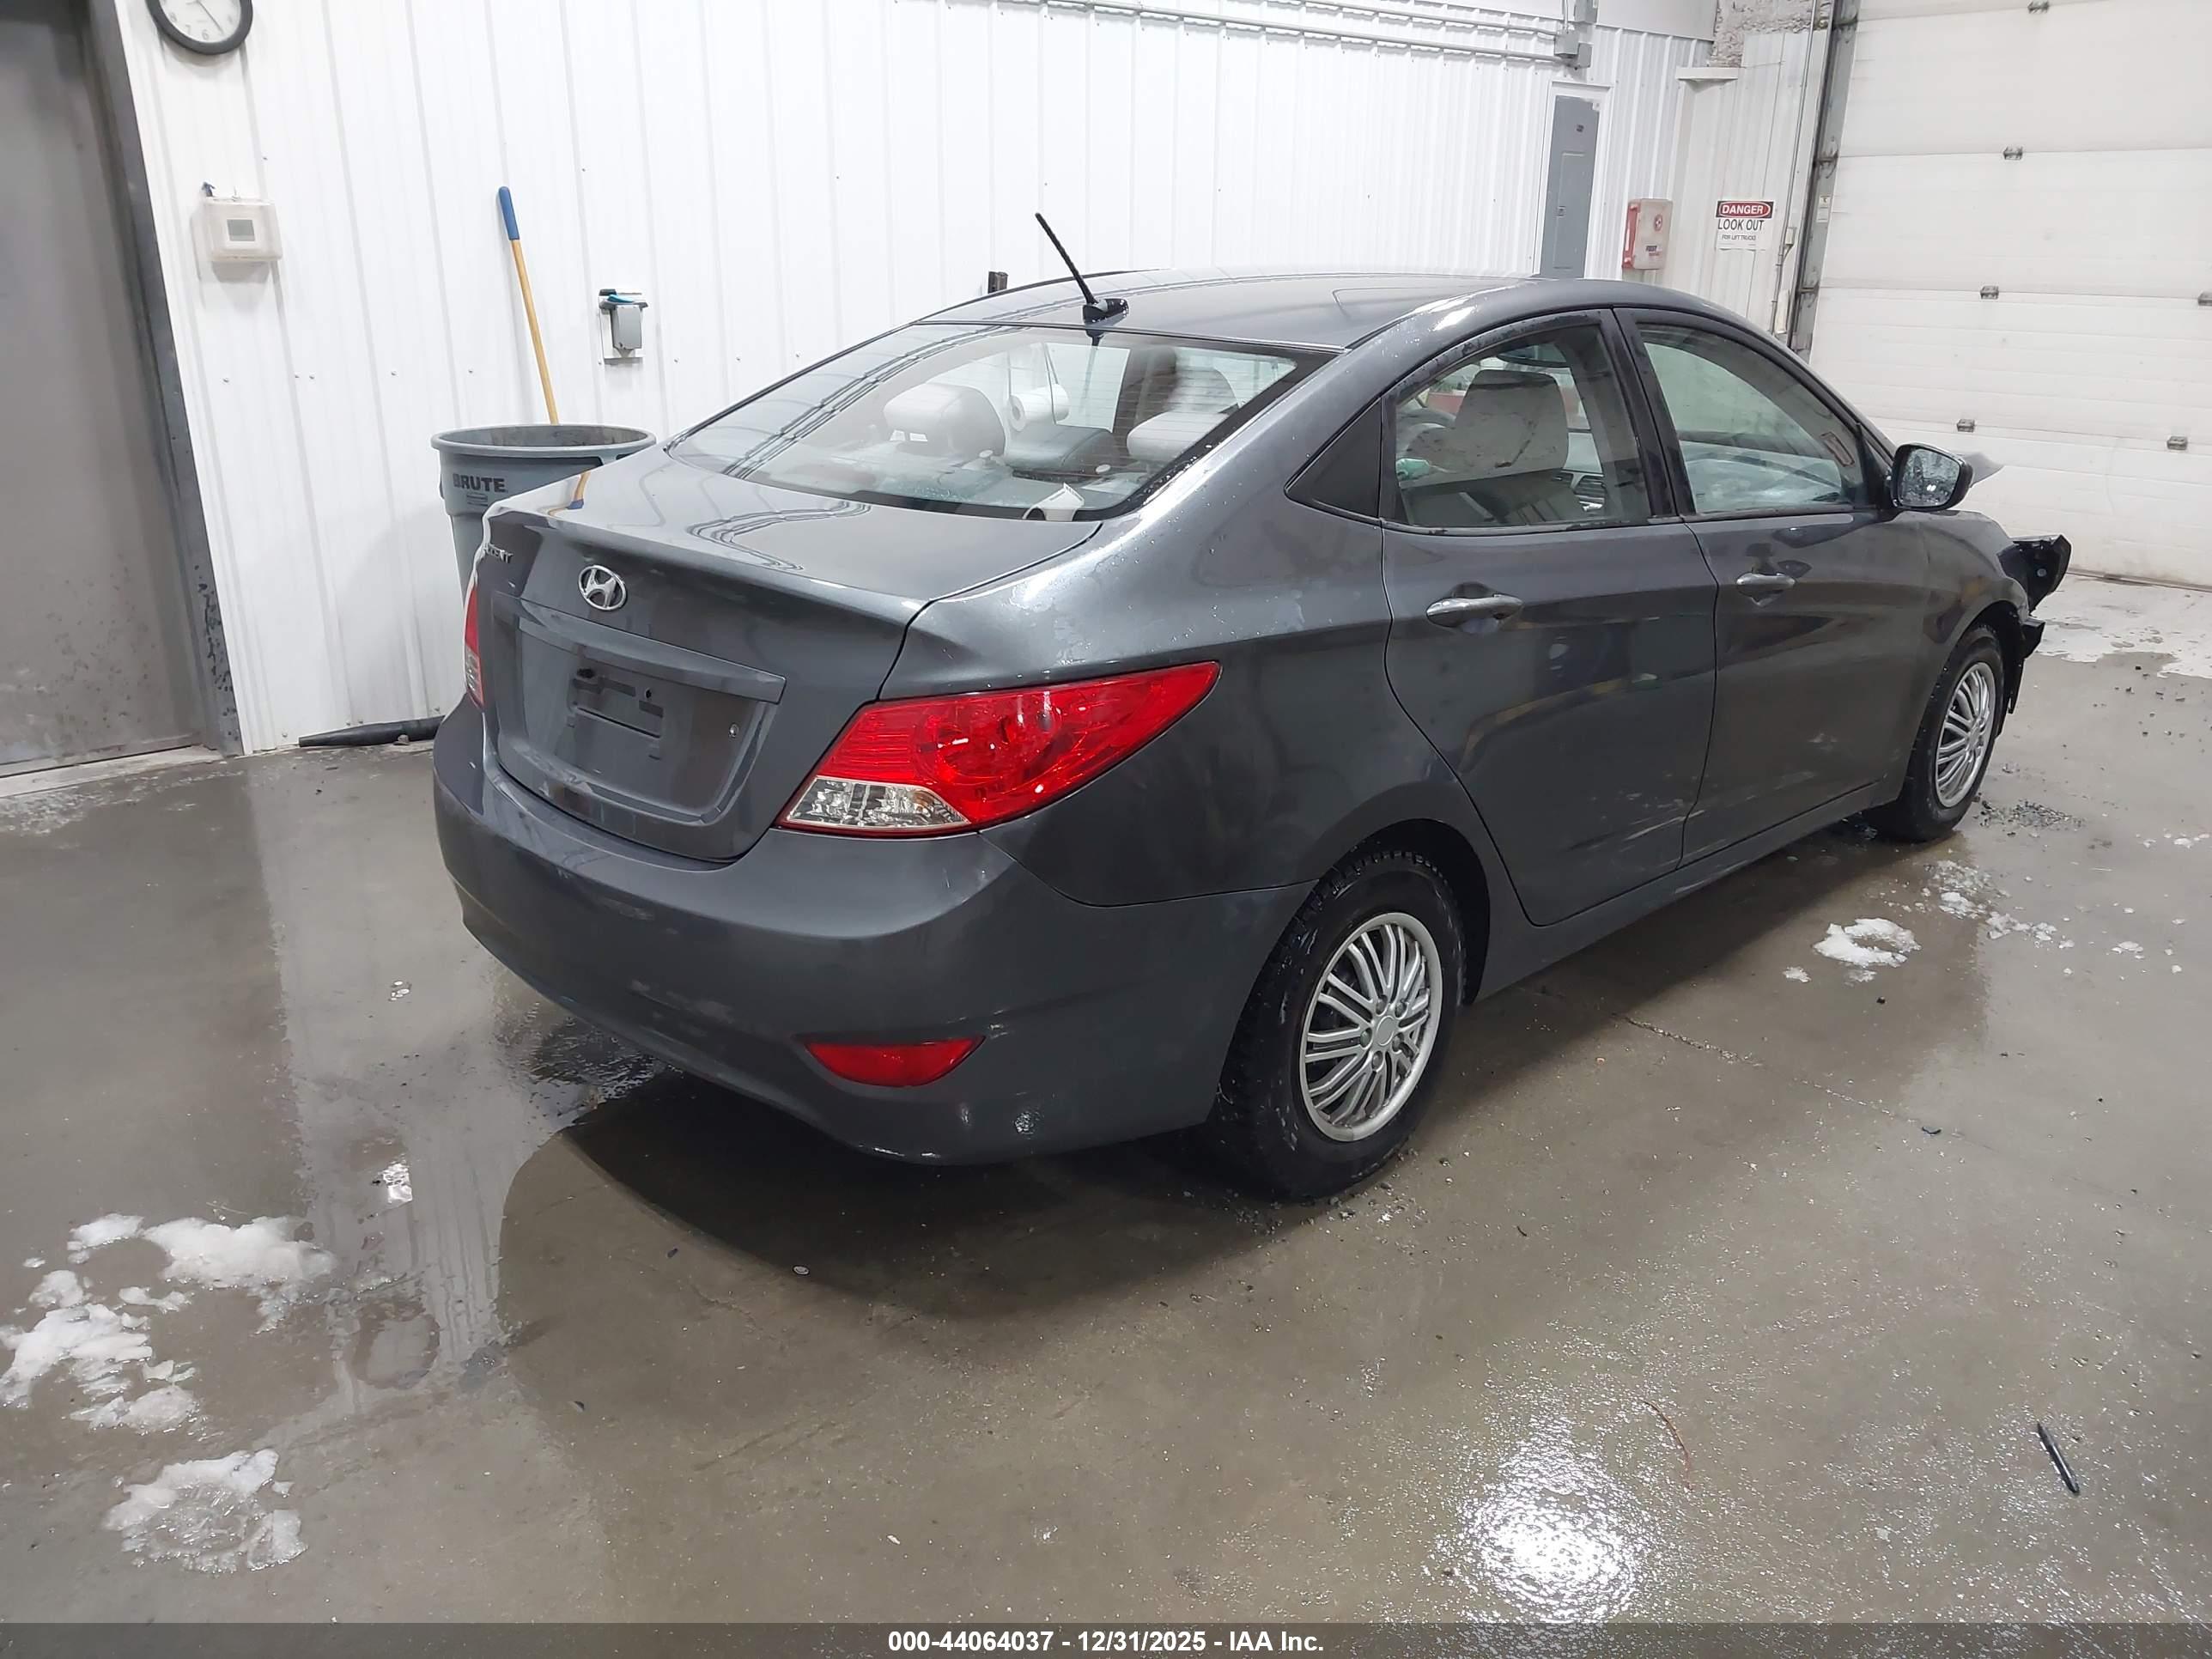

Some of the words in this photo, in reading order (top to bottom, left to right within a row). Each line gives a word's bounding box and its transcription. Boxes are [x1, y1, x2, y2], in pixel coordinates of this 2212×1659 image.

[201, 29, 210, 40] 6
[1722, 204, 1764, 215] DANGER
[1717, 218, 1744, 230] LOOK
[1746, 219, 1765, 231] OUT
[453, 472, 506, 493] BRUTE
